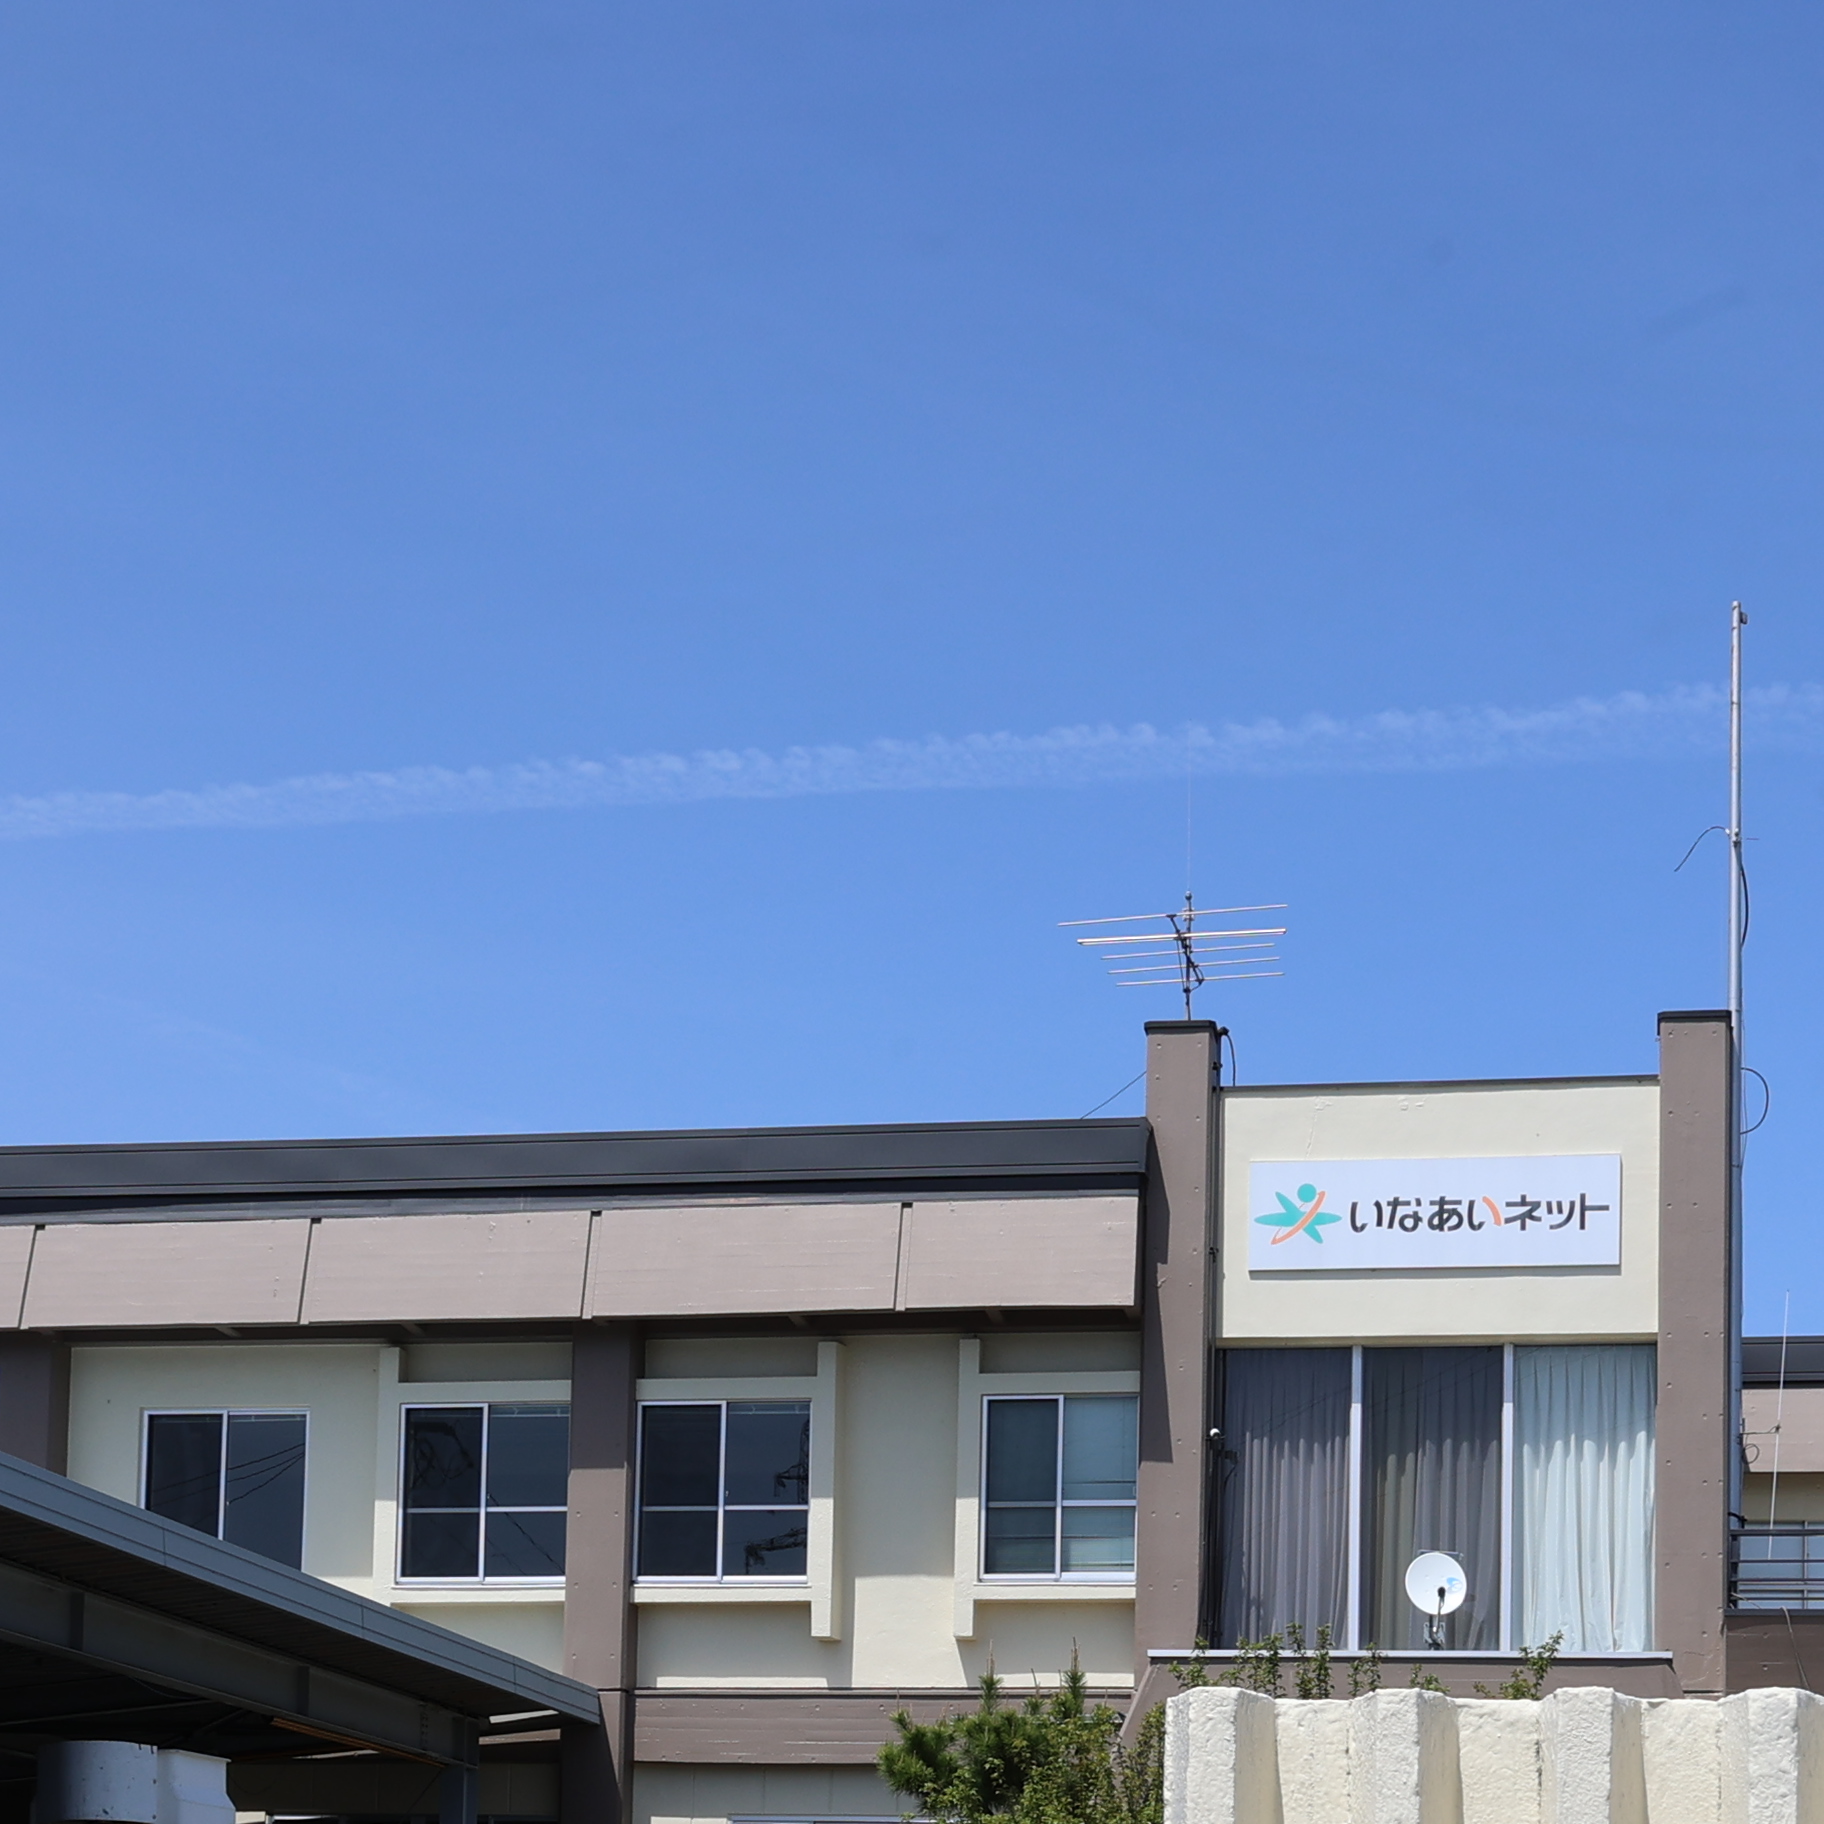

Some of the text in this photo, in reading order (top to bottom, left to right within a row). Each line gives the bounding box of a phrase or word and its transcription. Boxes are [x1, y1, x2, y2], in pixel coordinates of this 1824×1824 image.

[1349, 1192, 1610, 1234] いなあいネット
